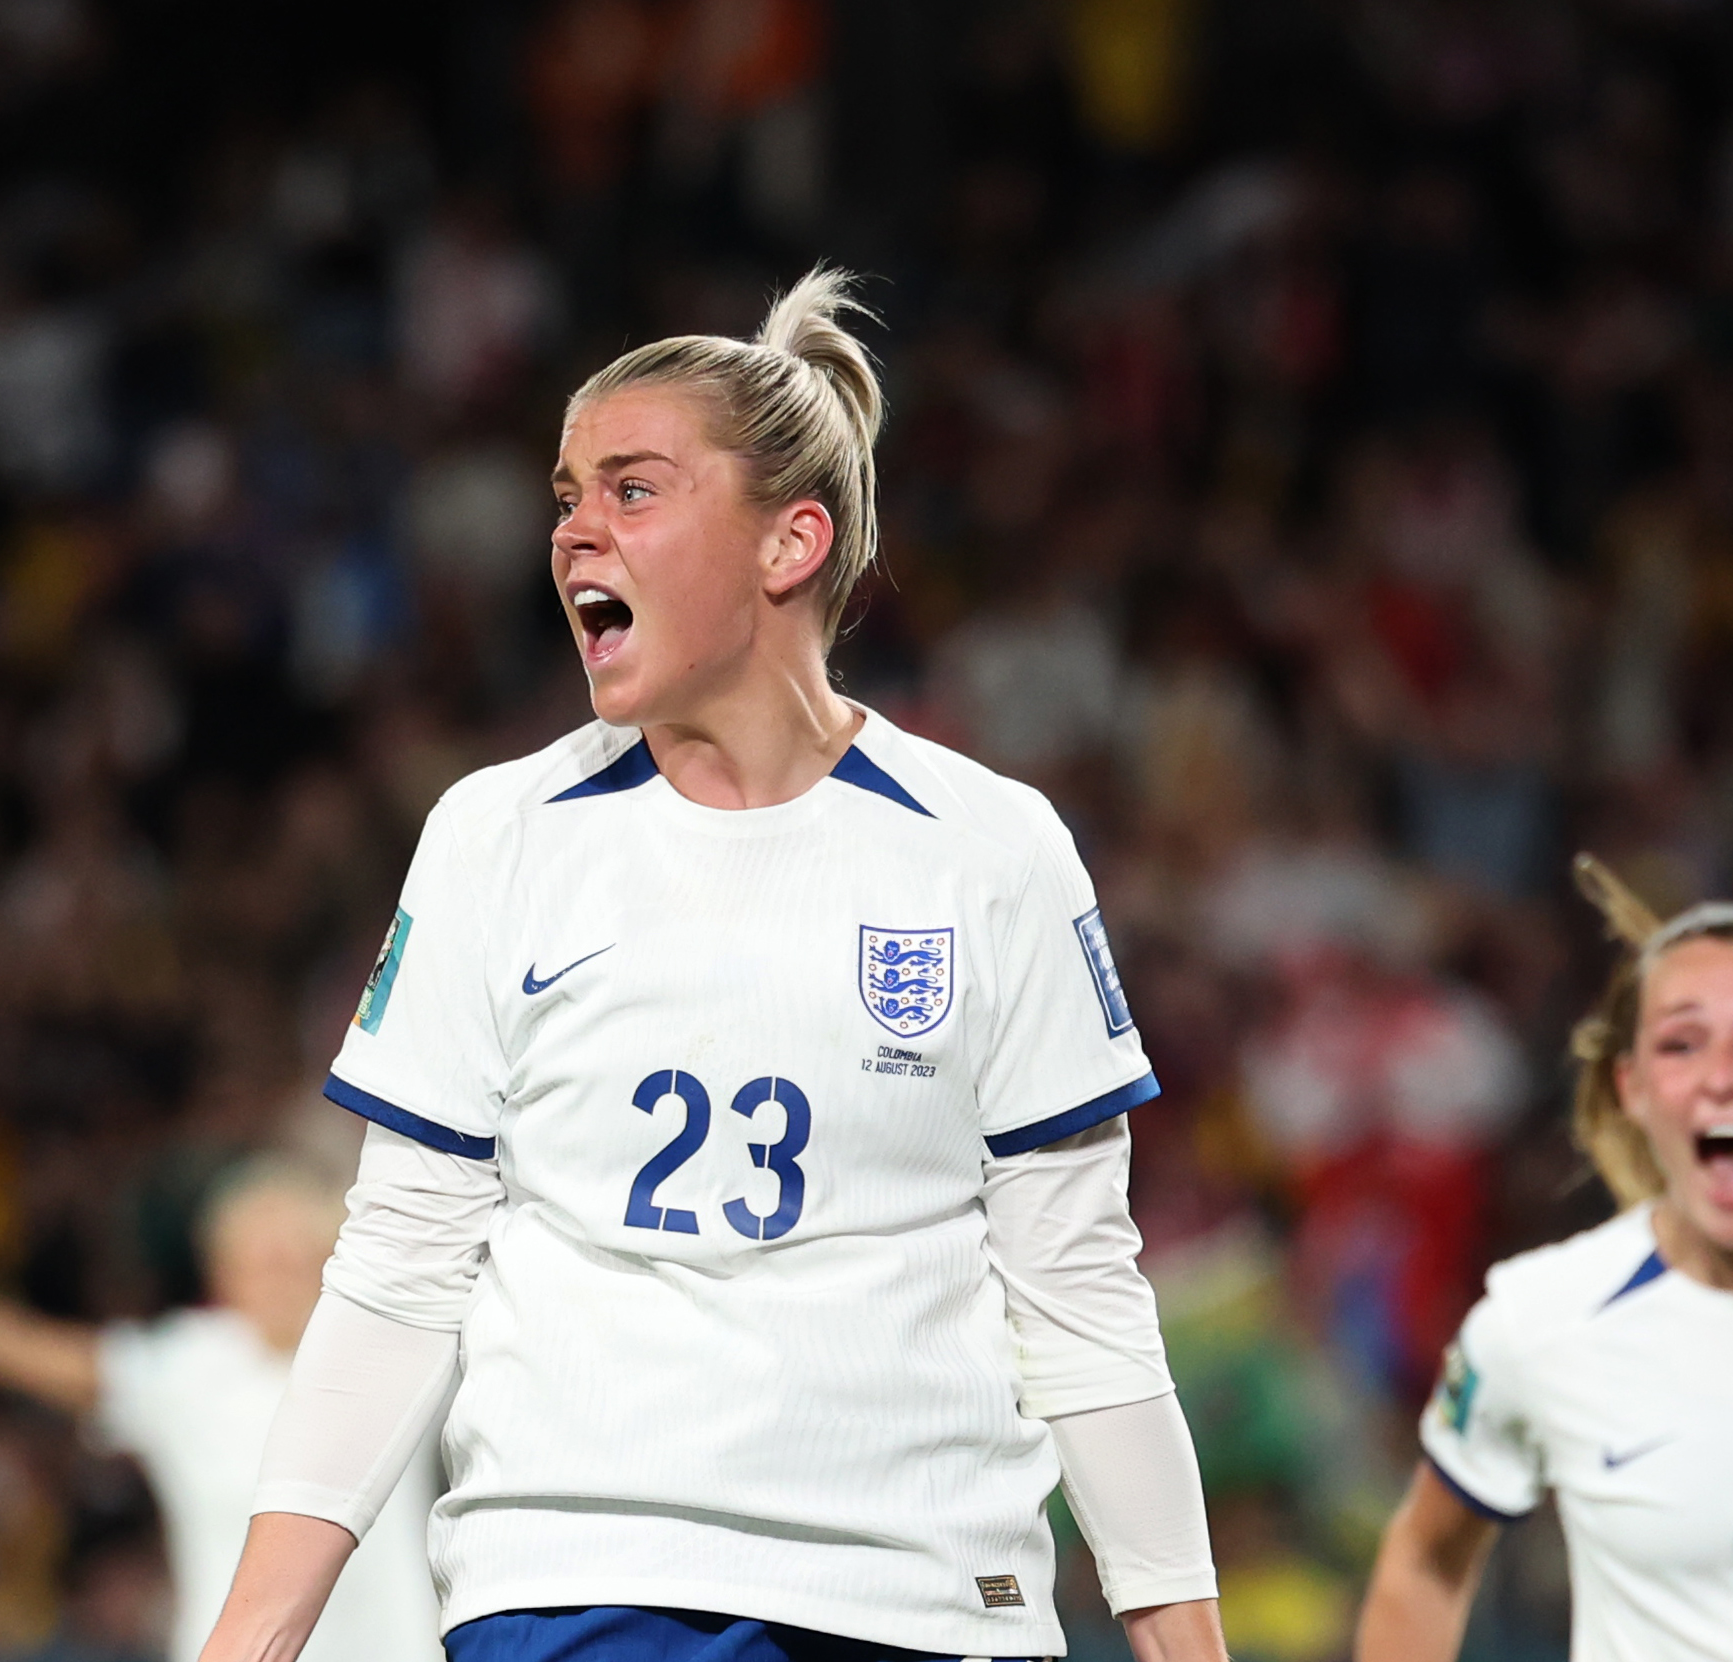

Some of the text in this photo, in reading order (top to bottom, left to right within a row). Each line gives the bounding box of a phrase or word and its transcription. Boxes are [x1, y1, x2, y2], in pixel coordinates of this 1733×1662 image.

[877, 1045, 922, 1062] COLOMBIA
[861, 1058, 936, 1078] 12 AUGUST 2023
[623, 1069, 812, 1241] 23
